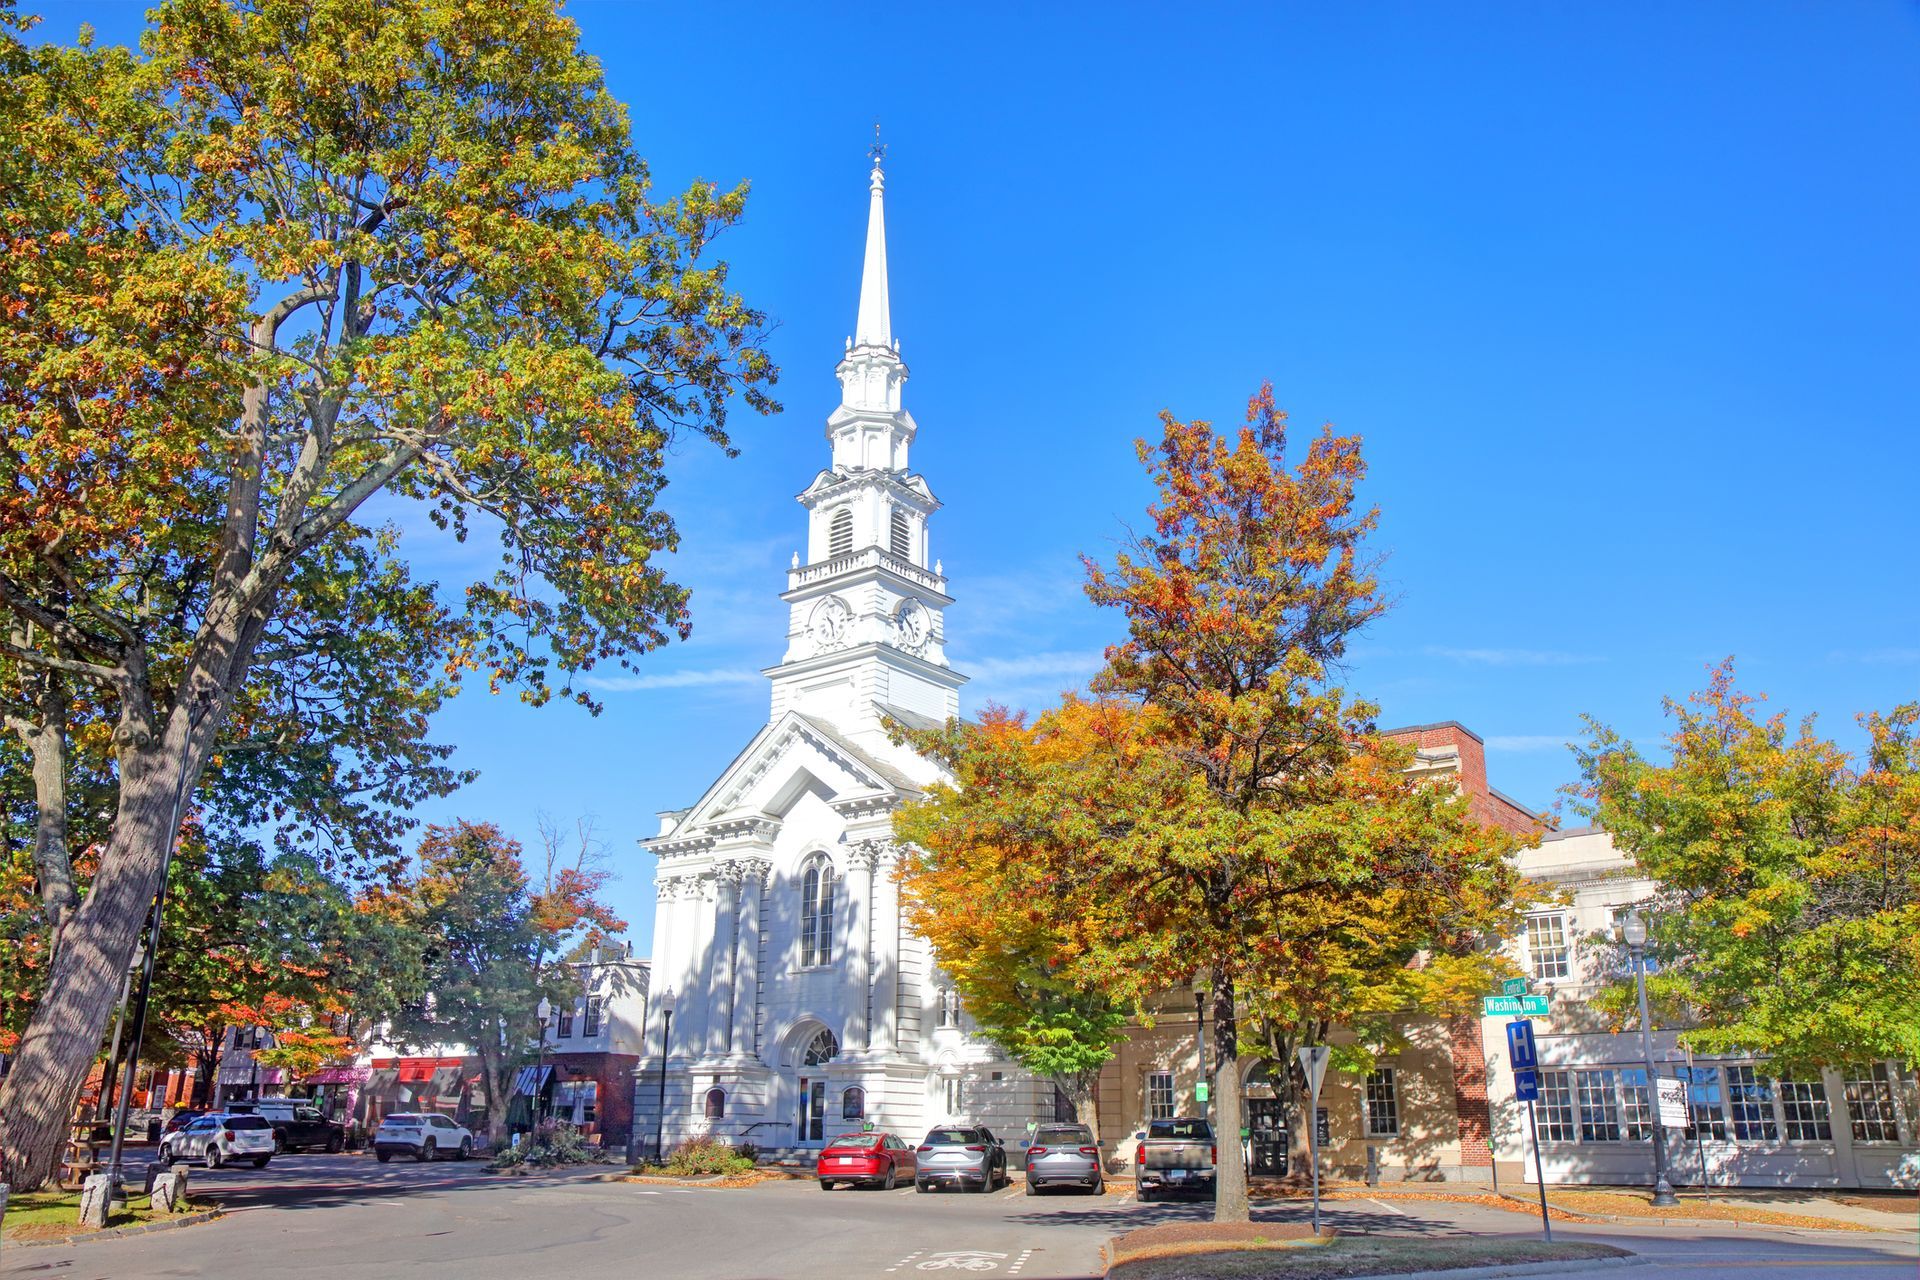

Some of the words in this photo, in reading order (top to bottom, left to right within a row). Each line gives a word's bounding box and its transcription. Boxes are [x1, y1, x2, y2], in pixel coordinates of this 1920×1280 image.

[1504, 980, 1521, 995] Central
[1487, 998, 1536, 1014] Washington
[1511, 1026, 1530, 1062] H
